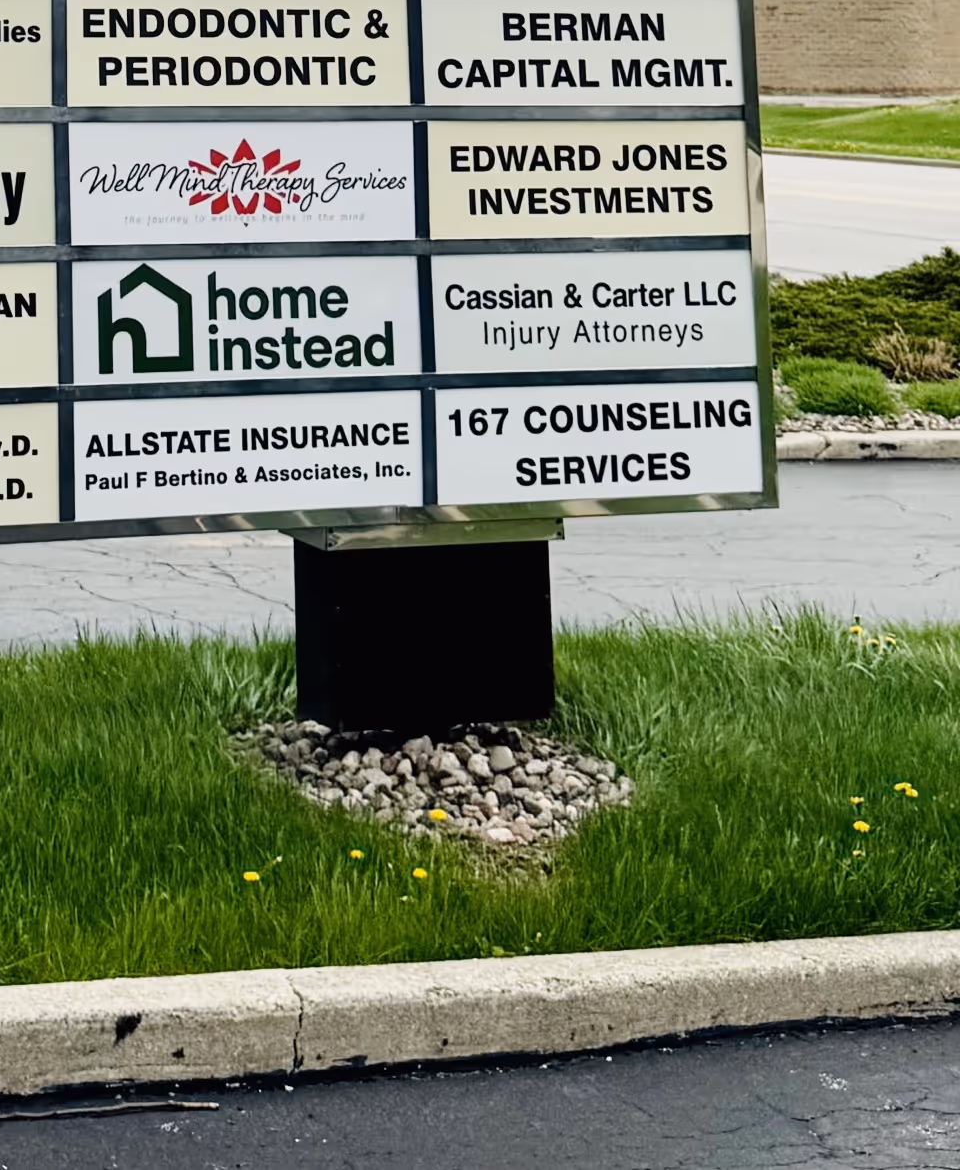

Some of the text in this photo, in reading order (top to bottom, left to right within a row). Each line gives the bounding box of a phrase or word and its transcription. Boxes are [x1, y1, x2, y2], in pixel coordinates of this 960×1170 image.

[83, 8, 389, 39] ENDODONTIC &
[503, 13, 665, 41] BERMAN
[99, 56, 376, 86] PERIODONTIC
[438, 59, 732, 88] CAPITAL MGMT.
[451, 144, 727, 172] EDWARD JONES
[80, 162, 407, 212] Well Mind Therapy Services
[469, 186, 713, 215] INVESTMENTS
[208, 271, 348, 320] home
[446, 281, 736, 310] Cassian & Carter LLC
[209, 321, 394, 371] instead
[484, 320, 703, 350] Injury Attorneys
[449, 400, 751, 436] 167 COUNSELING
[86, 423, 409, 457] ALLSTATE INSURANCE
[86, 462, 410, 490] Paul F Bertino & Associates, Inc.
[516, 452, 690, 486] SERVICES
